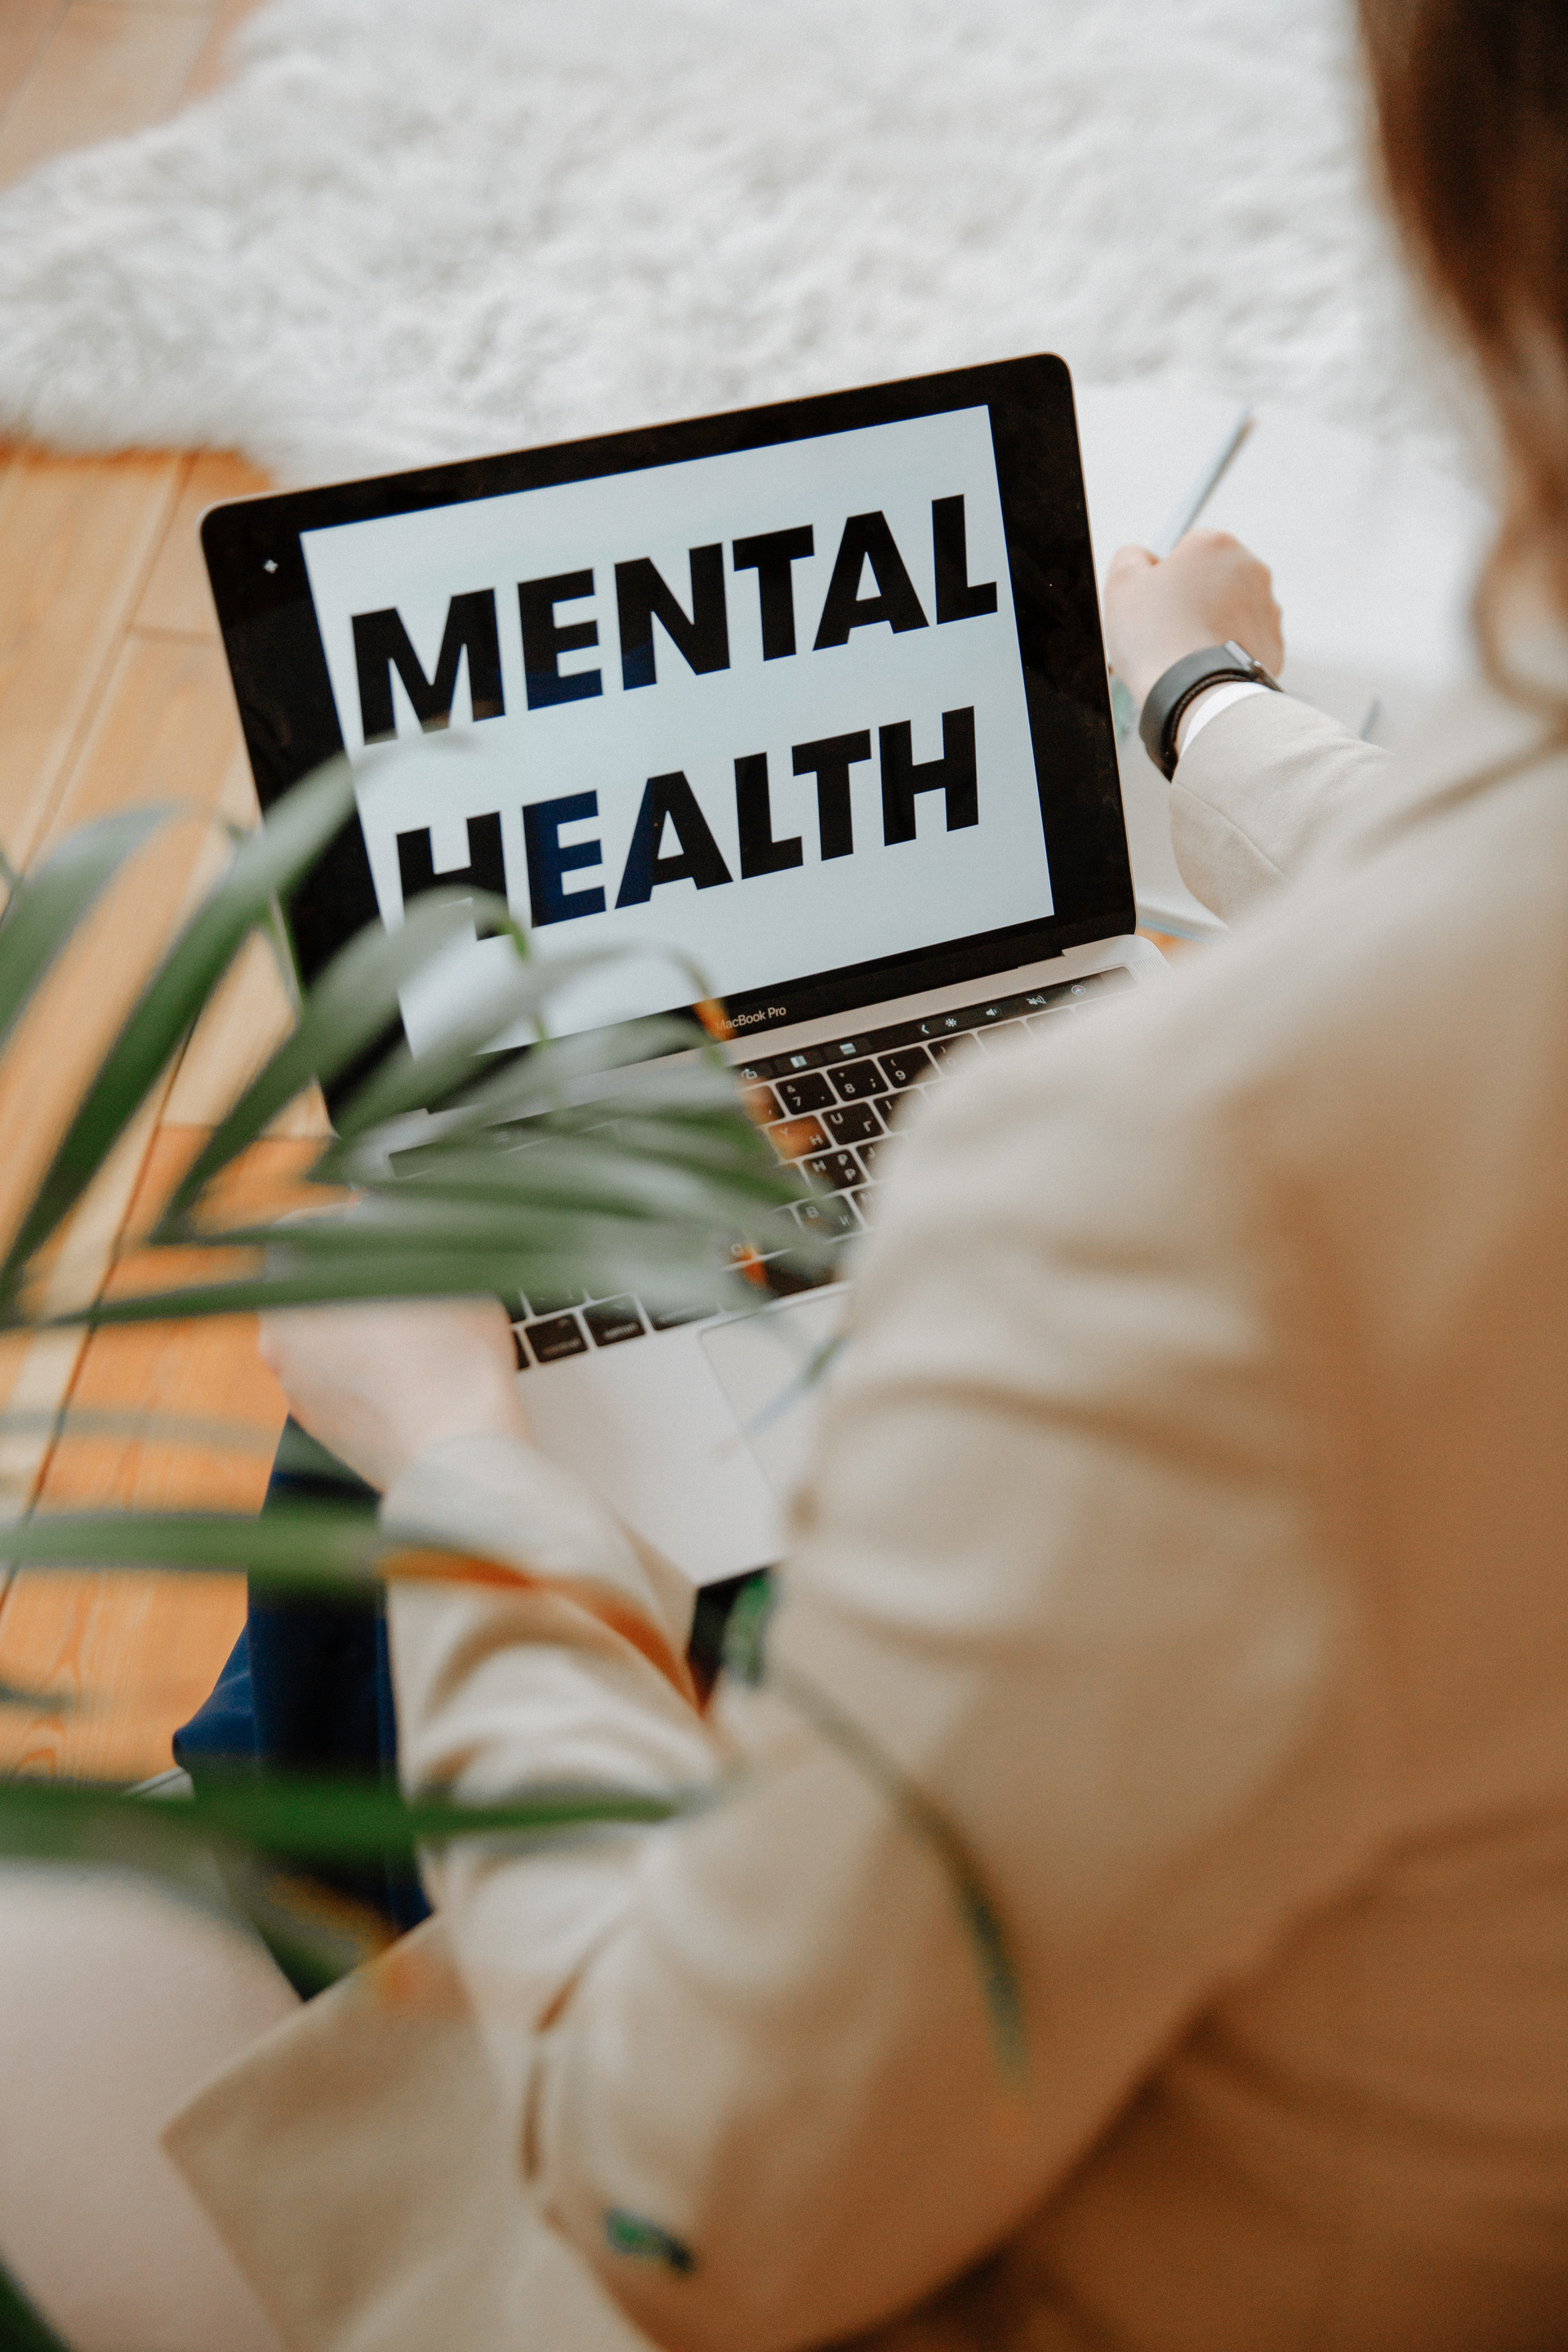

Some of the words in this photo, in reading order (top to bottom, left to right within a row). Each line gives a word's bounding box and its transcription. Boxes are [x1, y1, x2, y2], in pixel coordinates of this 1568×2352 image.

[351, 493, 998, 746] MENTAL
[396, 705, 979, 942] HEALTH
[717, 1010, 767, 1031] MacBook
[767, 1006, 787, 1019] Pro
[895, 1069, 906, 1080] 9
[844, 1082, 856, 1094] 8
[792, 1095, 801, 1107] 7
[830, 1111, 844, 1125] U
